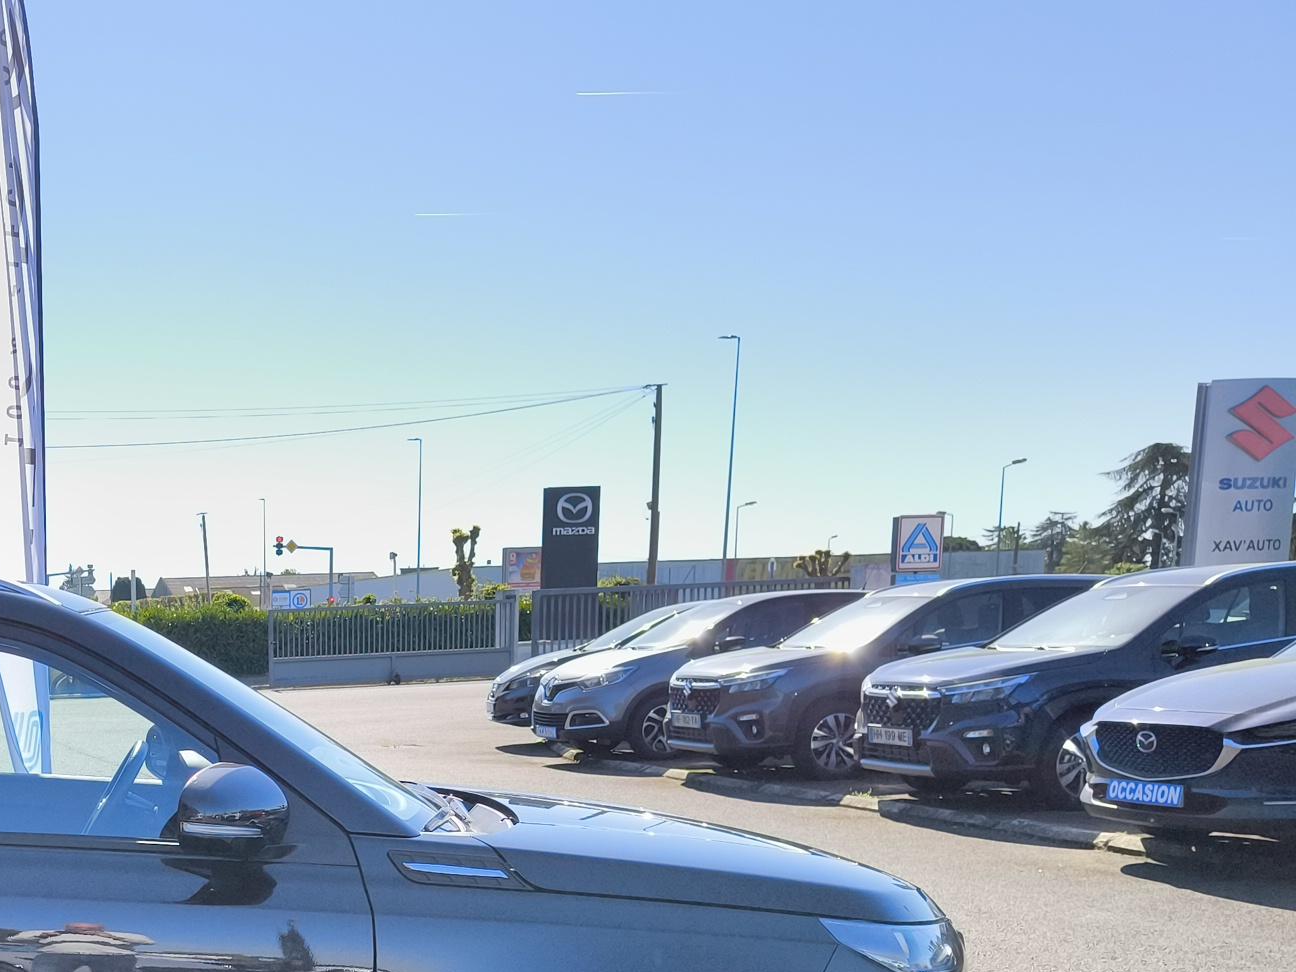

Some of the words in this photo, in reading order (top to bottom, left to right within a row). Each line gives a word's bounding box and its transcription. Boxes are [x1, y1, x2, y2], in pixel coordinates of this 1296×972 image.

[1218, 476, 1287, 490] SUZUKI
[1232, 499, 1273, 512] AUTO
[1211, 539, 1281, 552] XAV'AUTO
[902, 553, 936, 563] ALDI
[1109, 780, 1181, 805] OCCASION
